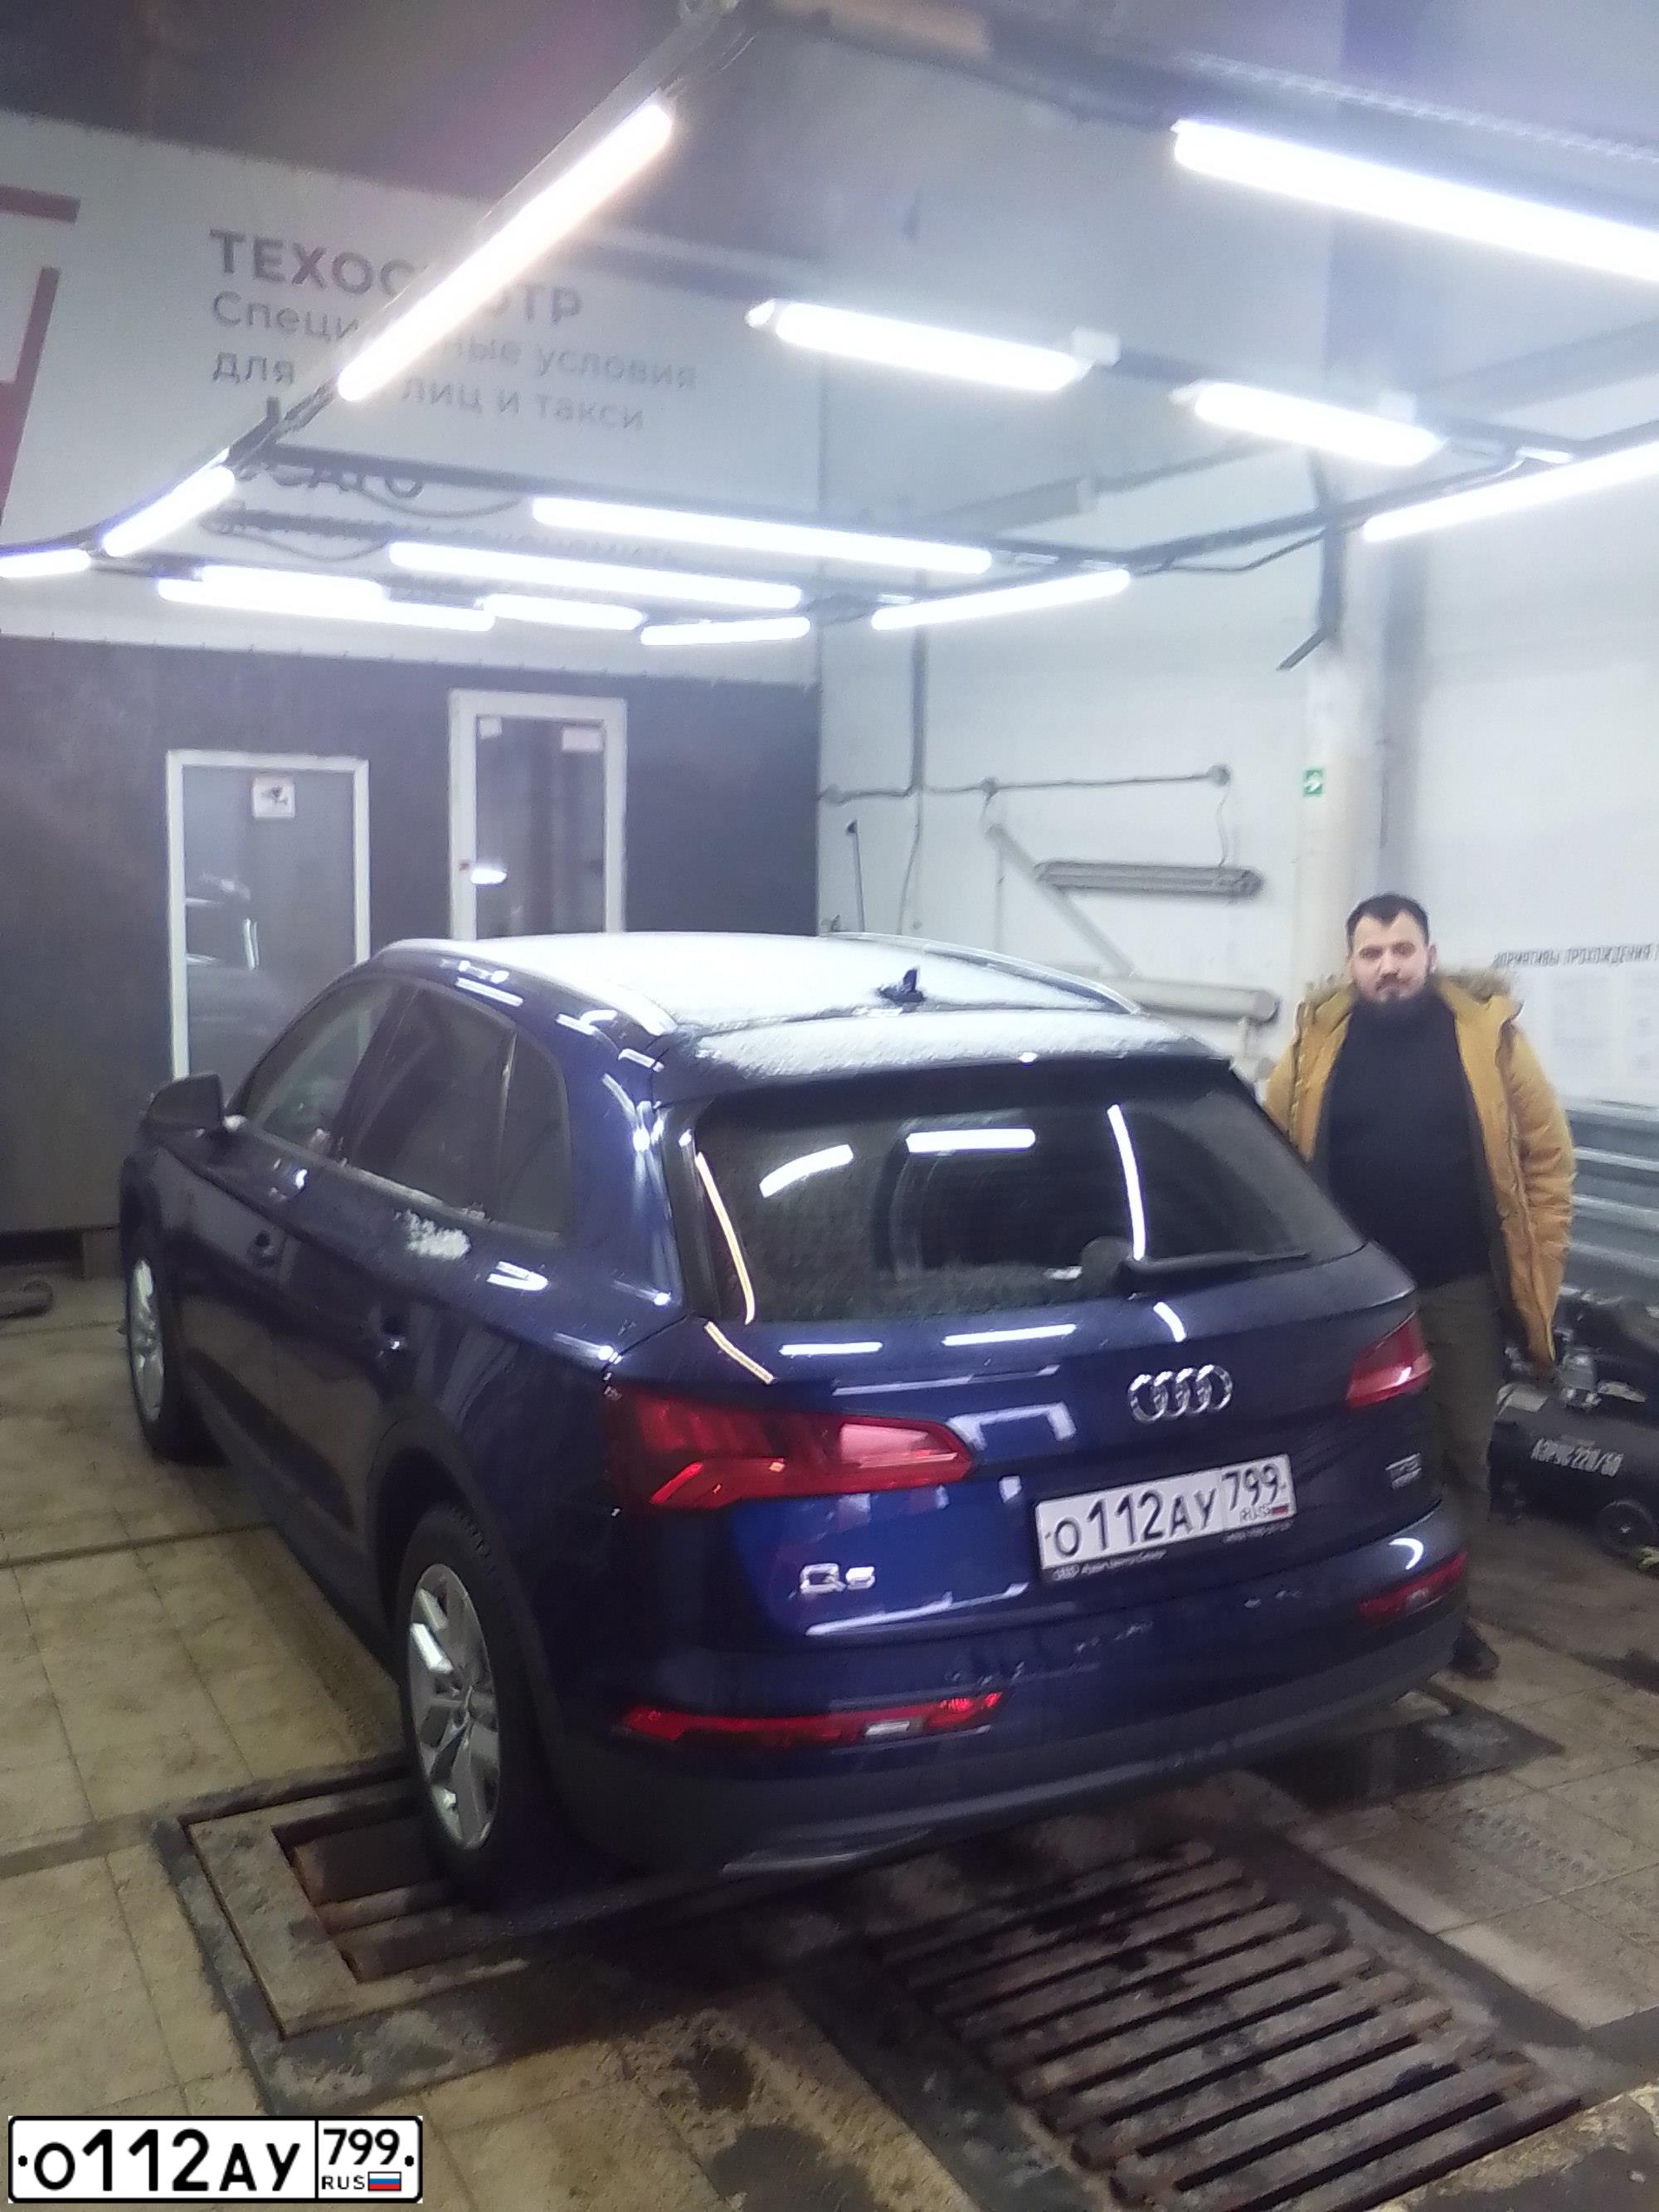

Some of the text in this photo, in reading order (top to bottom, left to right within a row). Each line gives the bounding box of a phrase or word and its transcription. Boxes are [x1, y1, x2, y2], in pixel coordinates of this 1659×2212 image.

[209, 227, 582, 325] ТЕХОСТР
[213, 290, 698, 390] Специные условия
[212, 351, 294, 384] для
[536, 393, 645, 430] такси
[1052, 1488, 1218, 1559] О112АУ
[1221, 1463, 1280, 1512] 799
